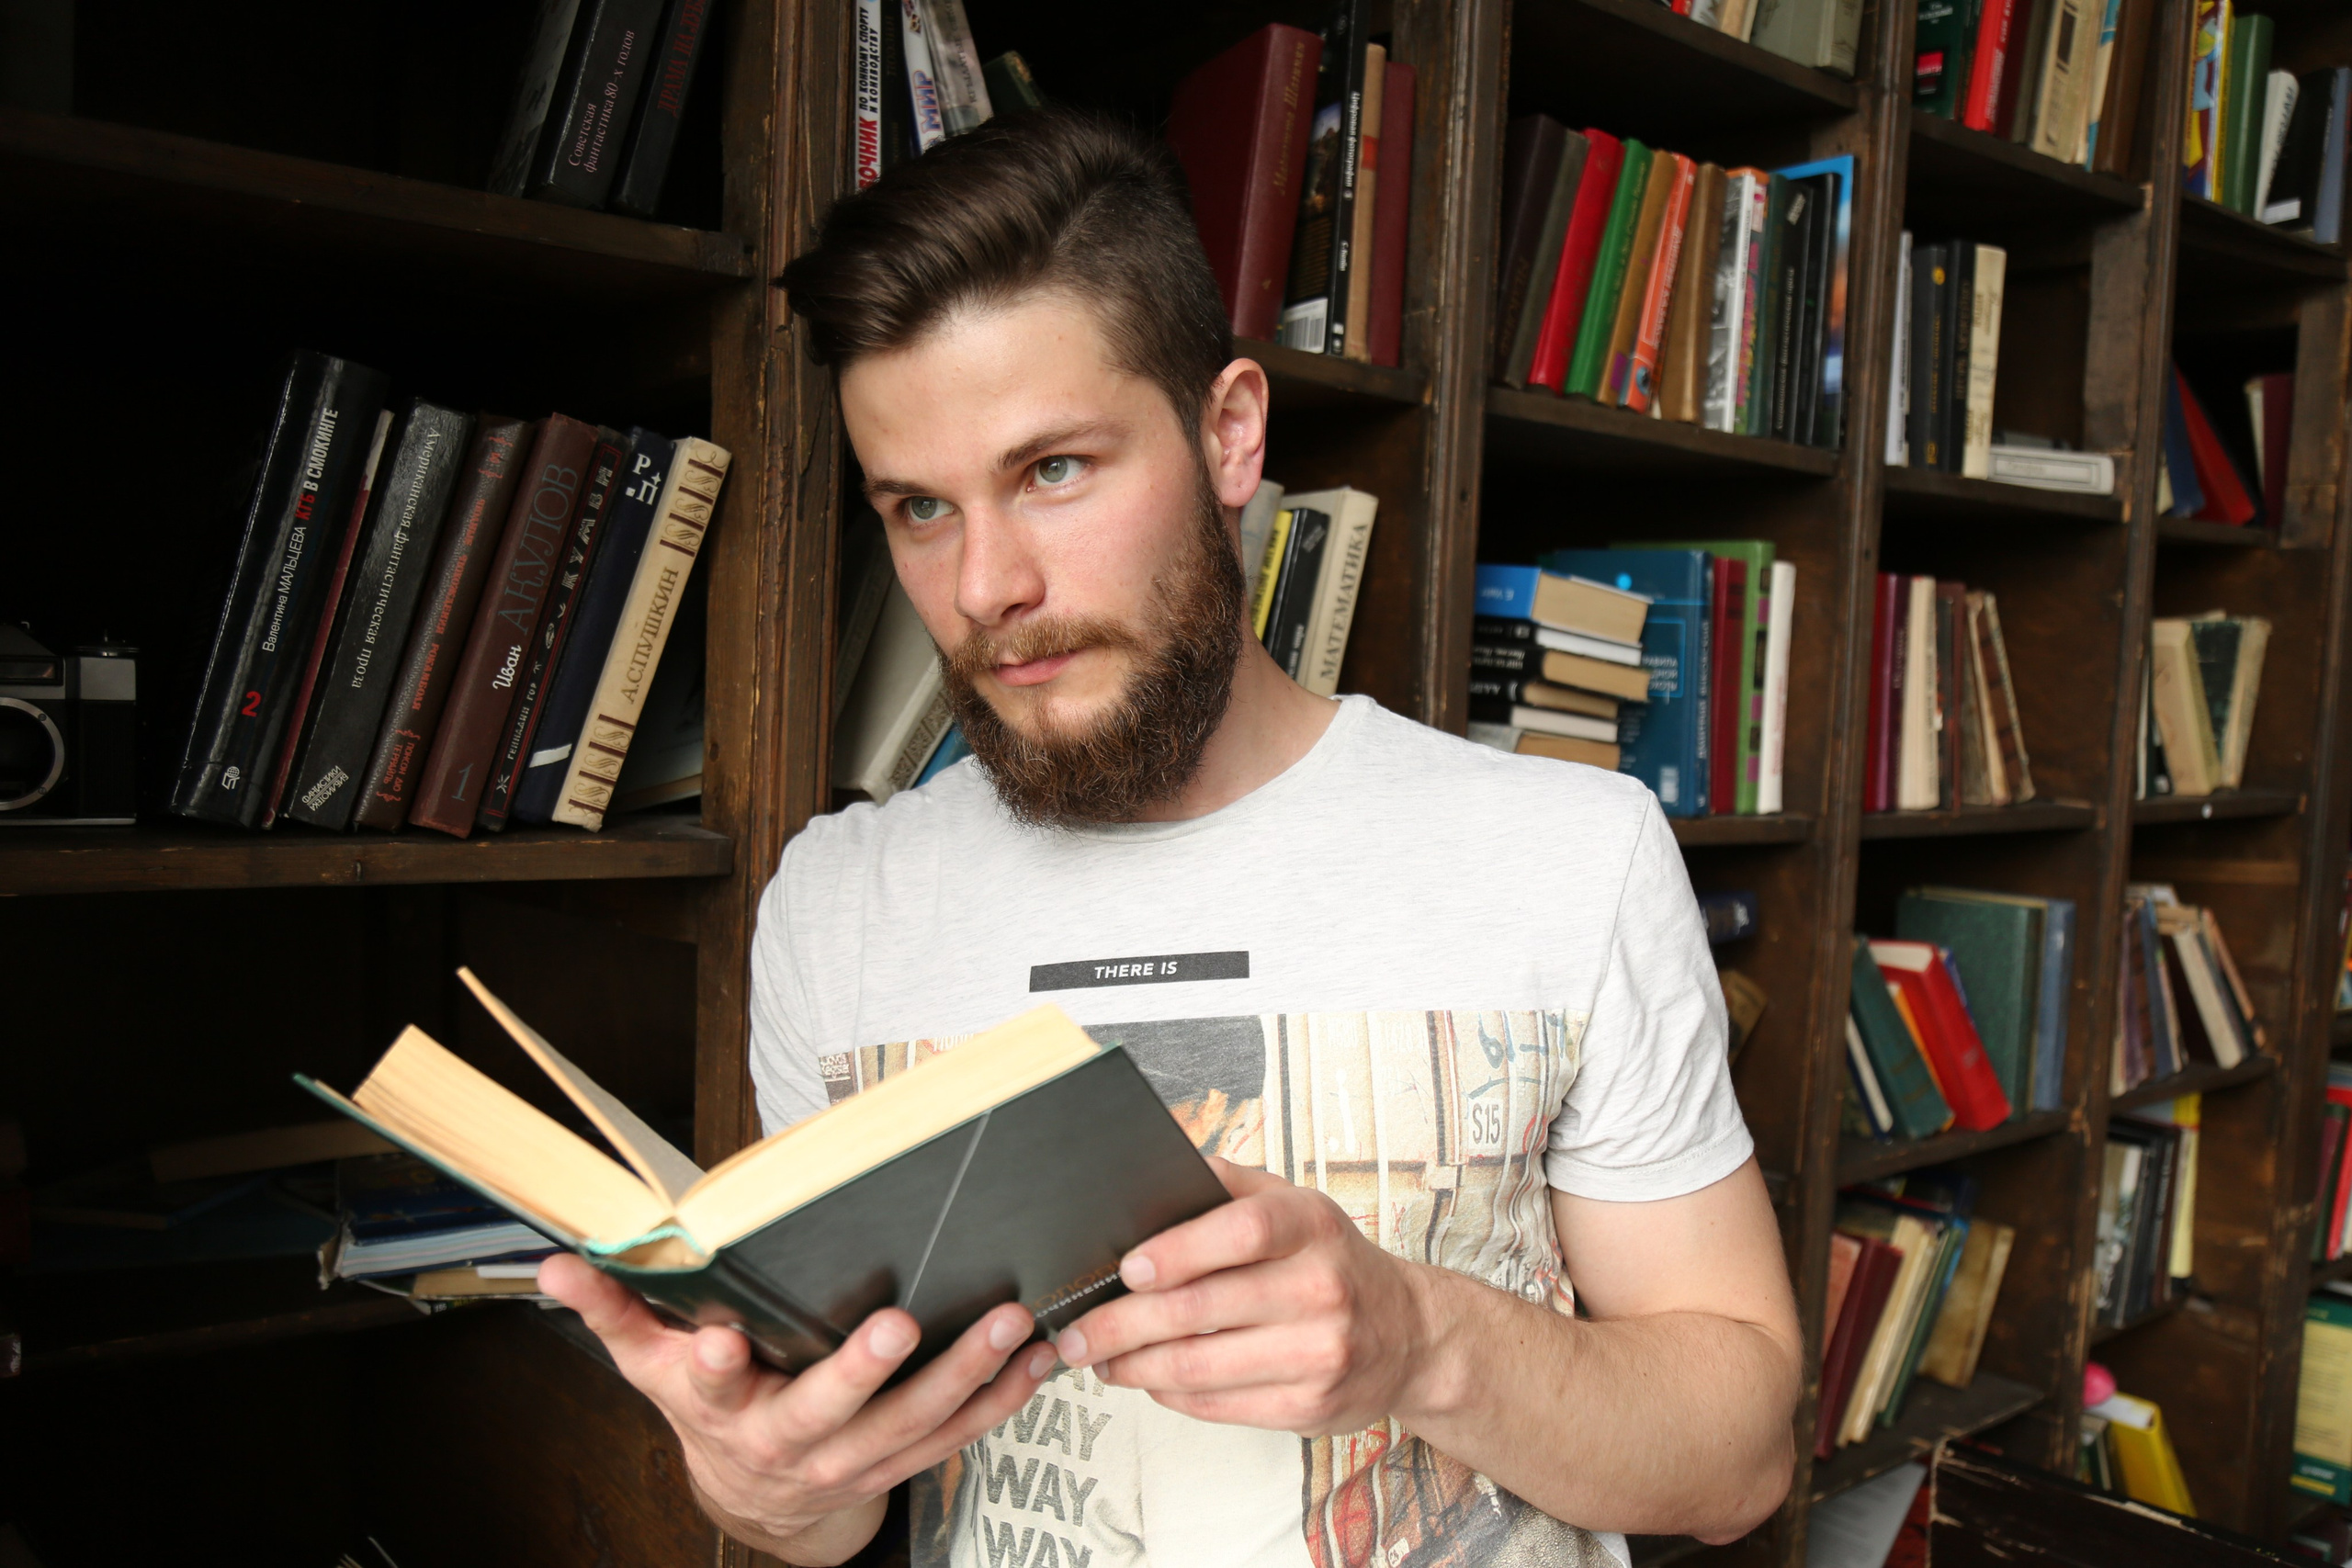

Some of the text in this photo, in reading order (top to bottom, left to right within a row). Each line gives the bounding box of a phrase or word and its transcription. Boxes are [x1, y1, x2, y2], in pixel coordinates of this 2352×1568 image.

[859, 7, 869, 110] ПО КОННОМУ СПОРТУ
[869, 28, 880, 114] И КОНЕВОДСТВУ
[582, 100, 615, 173] фантастика
[617, 30, 636, 66] годов
[912, 70, 943, 134] МИР
[568, 102, 597, 166] Советская
[295, 408, 338, 522] КГБ В СМОКИНГЕ
[351, 427, 441, 690] Американская фантастическая проза
[498, 462, 579, 635] АКУЛОВ
[263, 525, 307, 653] Валентина МАЛЬЦЕВА
[1319, 525, 1368, 679] МАТЕМАТИКА
[412, 642, 440, 711] РОКАМБОЛЯ
[492, 645, 523, 692] Иван
[526, 675, 538, 702] ГОР
[241, 691, 262, 716] 2
[308, 771, 350, 814] БИБЛИОТЕКА
[382, 742, 403, 789] ТЕРРАЙЛЬ
[394, 741, 416, 795] ПОНСОН ДЮ
[451, 762, 475, 802] 1
[1094, 961, 1178, 979] THERE IS
[1472, 1103, 1501, 1145] S15
[1034, 1271, 1120, 1320] ОЧИНЕНИ
[991, 1393, 1113, 1461] WAY
[986, 1446, 1098, 1528] WAY
[982, 1515, 1094, 1568] WAY
